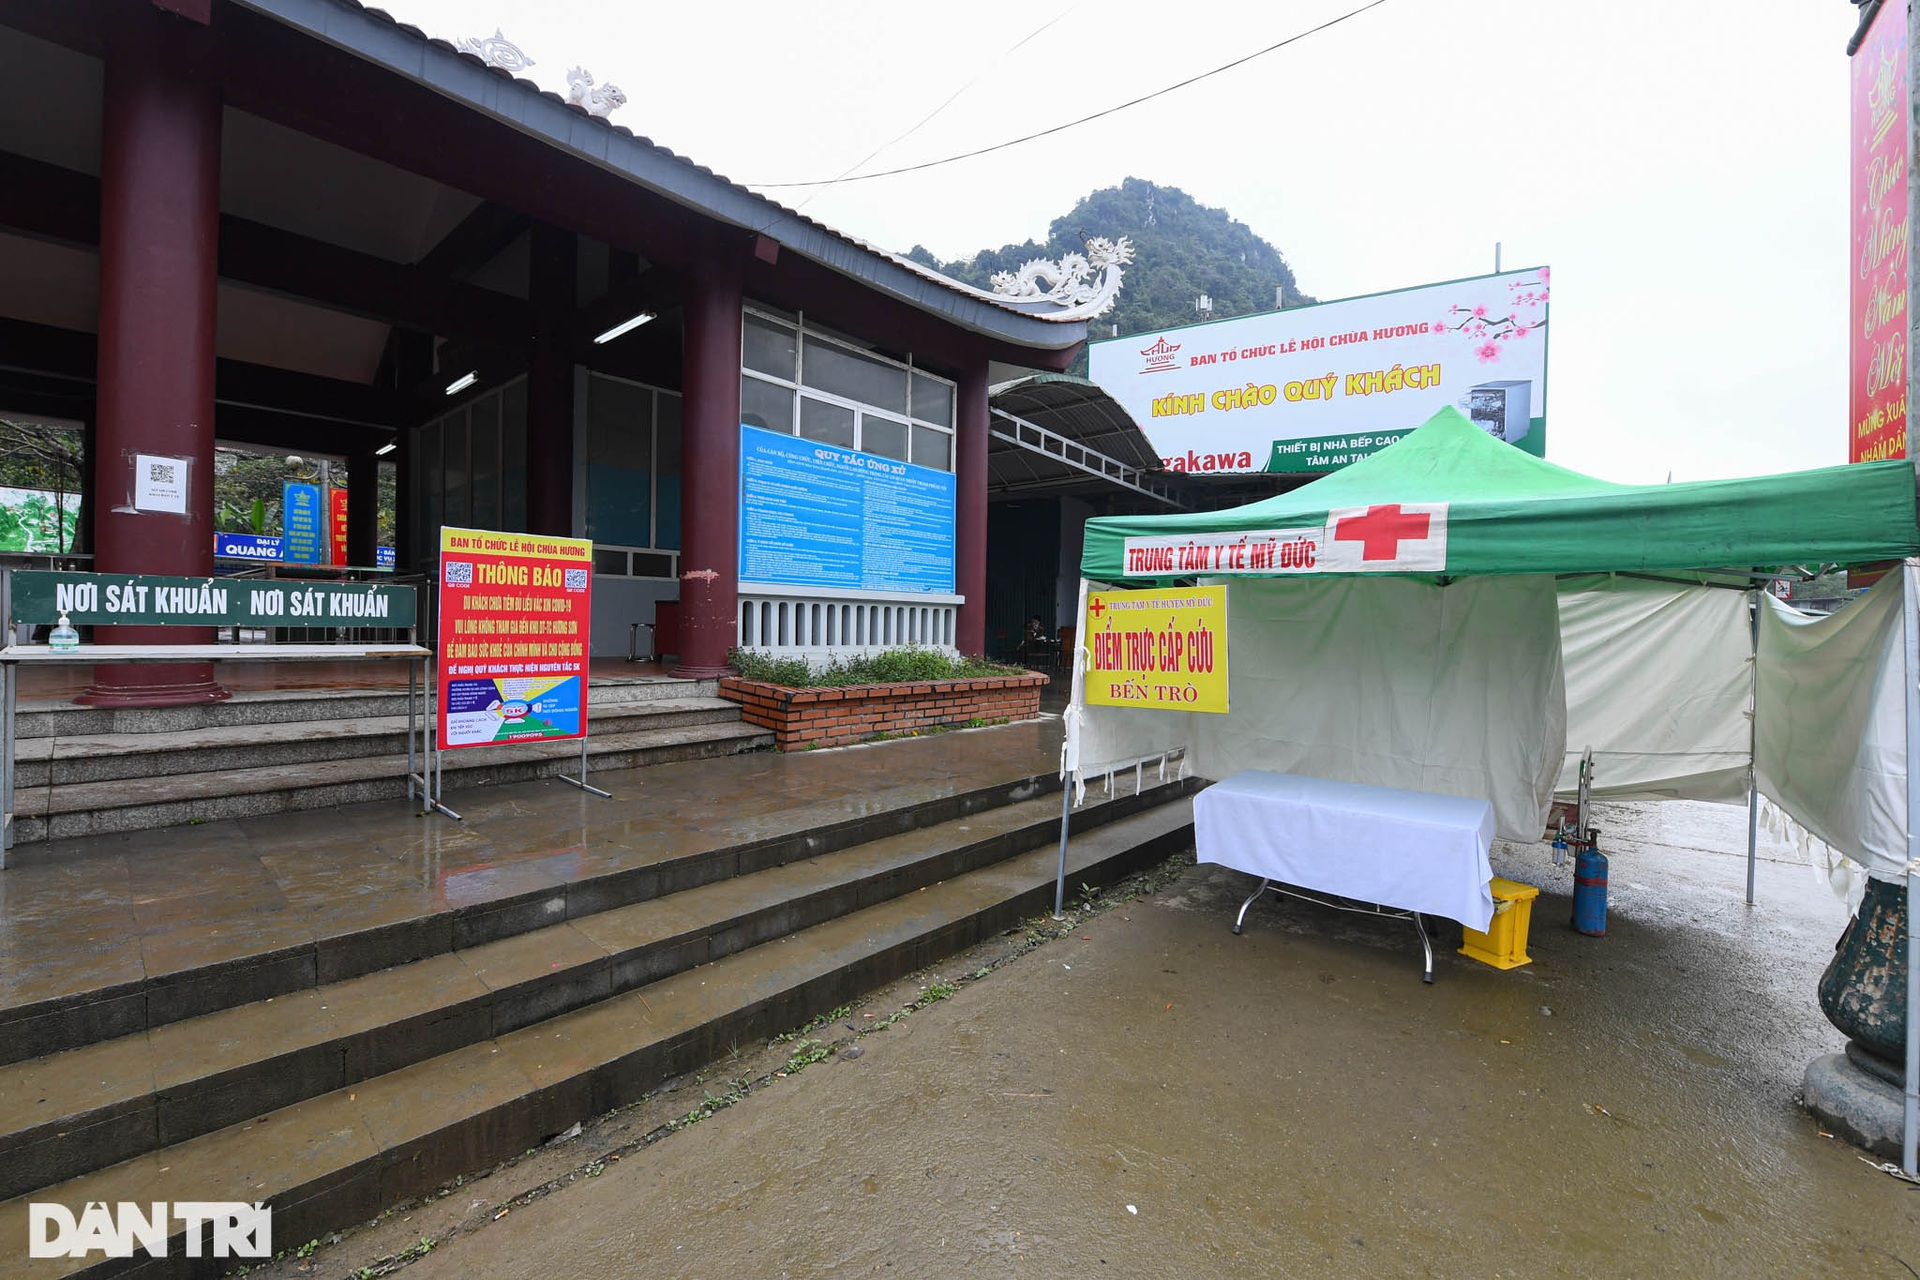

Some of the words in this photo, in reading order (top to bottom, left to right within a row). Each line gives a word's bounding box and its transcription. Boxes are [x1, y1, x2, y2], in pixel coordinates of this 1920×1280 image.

[1867, 147, 1904, 210] Chúc
[1864, 270, 1906, 340] Năm
[1190, 355, 1214, 367] BAN
[1220, 345, 1238, 363] TỔ
[1240, 343, 1276, 359] CHỨC
[1280, 338, 1297, 354] LỄ
[1300, 336, 1325, 352] HỘI
[1329, 329, 1368, 346] CHÙA
[1373, 322, 1429, 340] HƯƠNG
[1151, 392, 1205, 418] KÍNH
[1211, 383, 1277, 411] CHÀO
[1283, 372, 1338, 402] QUÝ
[1345, 363, 1441, 397] KHÁCH
[1277, 441, 1307, 454] THIẾT
[1310, 442, 1321, 453] BỊ
[1323, 438, 1348, 450] NHÀ
[1350, 435, 1373, 448] BẾP
[814, 448, 840, 462] QUY
[842, 453, 865, 467] TẮC
[867, 458, 890, 473] ỨNG
[890, 464, 907, 475] XỬ
[1306, 455, 1329, 466] TÂM
[1332, 455, 1348, 464] AN
[225, 544, 277, 558] QUANG
[256, 538, 270, 546] ĐẠI
[450, 537, 469, 548] BAN
[472, 535, 483, 549] TỔ
[485, 538, 508, 551] CHỨC
[521, 541, 535, 555] HỘI
[560, 545, 585, 557] HƯƠNG
[1129, 547, 1174, 572] TRUNG
[1178, 540, 1210, 571] TÂM
[1214, 545, 1225, 570] Y
[1229, 536, 1248, 569] TẾ
[1250, 538, 1276, 569] MỸ
[1280, 536, 1316, 569] ĐỨC
[477, 561, 529, 586] THÔNG
[533, 564, 562, 587] BÁO
[56, 582, 98, 612] NƠI
[105, 580, 148, 613] SÁT
[155, 578, 227, 614] KHUẨN
[250, 589, 284, 616] NƠI
[290, 587, 325, 617] SÁT
[330, 585, 388, 618] KHUẨN
[471, 592, 489, 610] KHÁCH
[551, 598, 572, 613] COVID-19
[1109, 602, 1130, 610] TRUNG
[1132, 599, 1145, 610] TÂM
[1146, 600, 1150, 609] Y
[1152, 597, 1160, 608] TẾ
[1161, 597, 1184, 609] HUYỆN
[1186, 596, 1196, 607] MỸ
[1198, 596, 1213, 607] ĐỨC
[478, 616, 495, 634] KHÔNG
[496, 619, 510, 634] THAM
[1095, 616, 1123, 671] ĐIỂM
[1125, 628, 1155, 680] TRỰC
[1158, 616, 1183, 672] CẤP
[1187, 618, 1214, 674] CỨU
[458, 665, 474, 676] NGHỊ
[474, 663, 487, 675] QUÝ
[487, 663, 508, 674] KHÁCH
[509, 664, 524, 674] THỰC
[524, 662, 539, 674] HIỆN
[539, 662, 561, 673] NGUYÊN
[573, 663, 580, 671] 5K
[1110, 679, 1148, 700] BẾN
[1155, 679, 1198, 702] TRÒ
